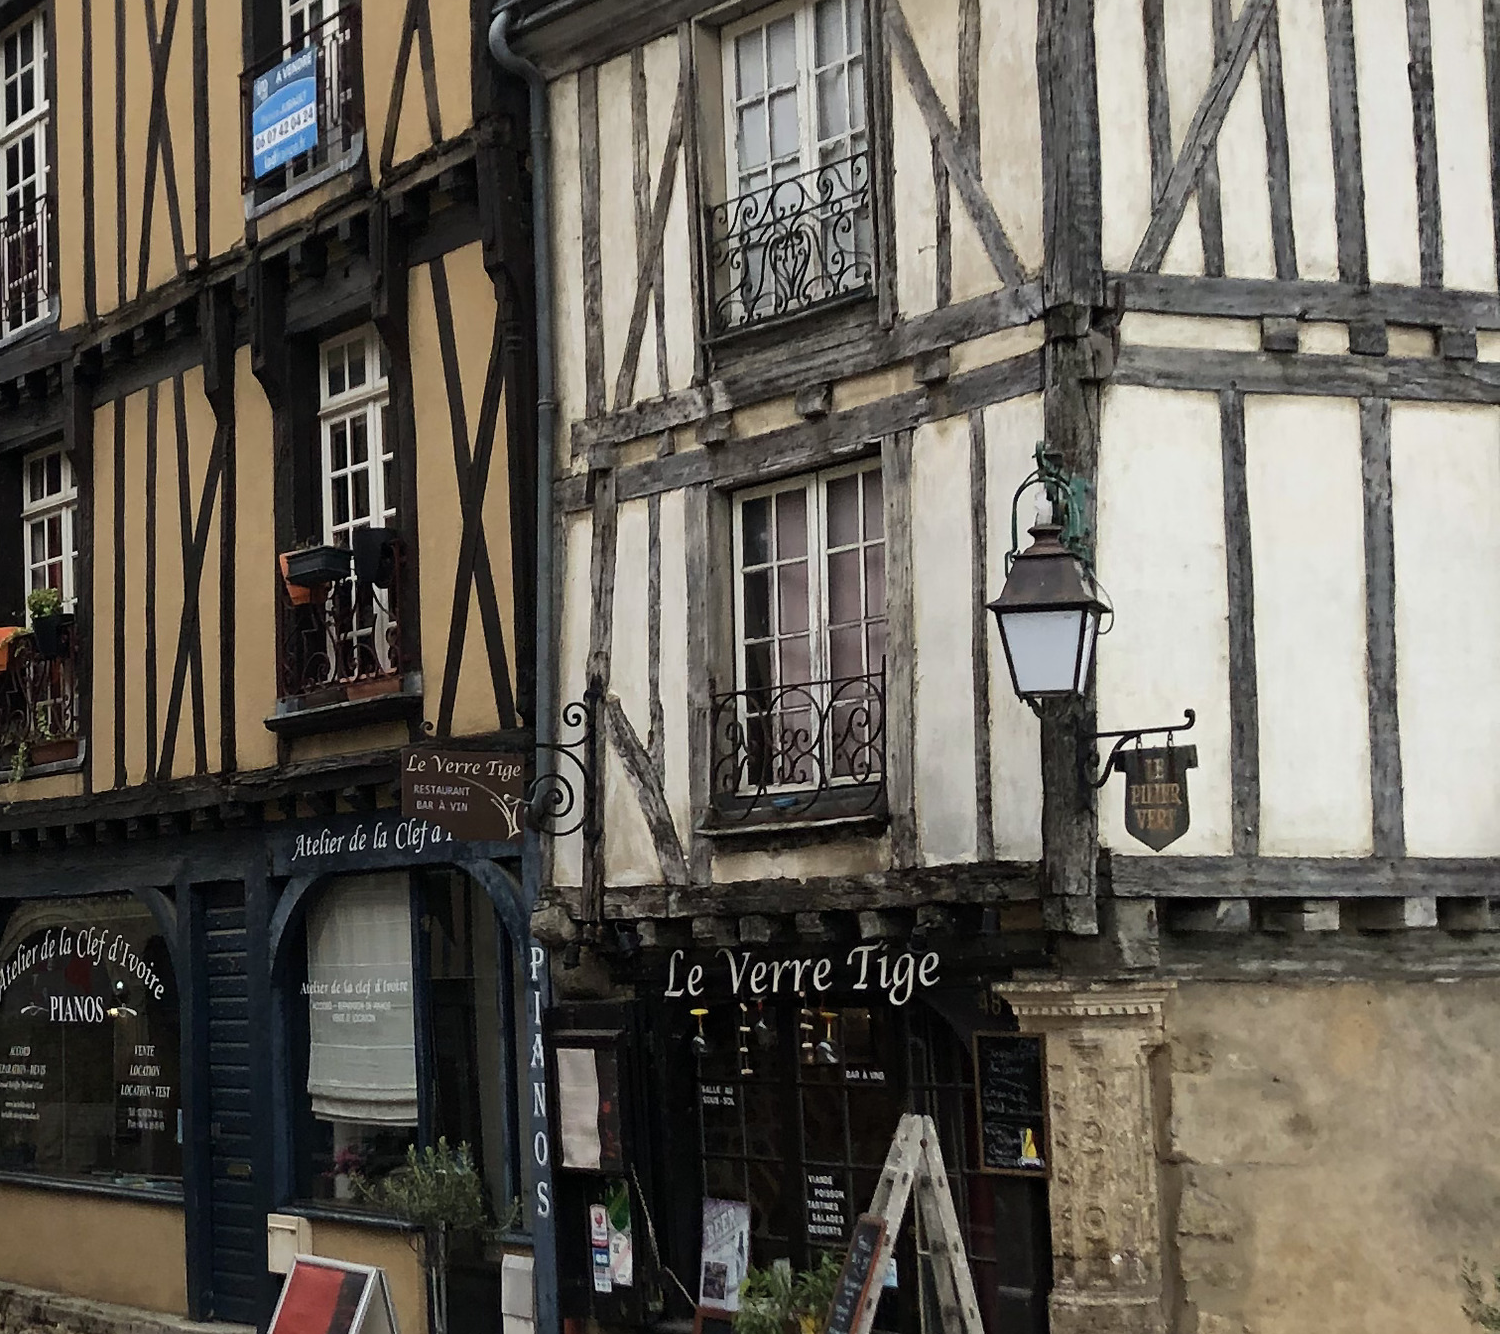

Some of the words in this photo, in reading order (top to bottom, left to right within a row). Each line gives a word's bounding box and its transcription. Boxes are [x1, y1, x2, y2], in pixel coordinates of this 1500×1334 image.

[279, 121, 289, 136] 42
[303, 107, 313, 122] 24
[406, 753, 426, 772] Le
[430, 754, 481, 775] Verre
[485, 759, 521, 782] Tige
[1145, 758, 1165, 779] LE
[413, 784, 471, 796] RESTAURANT
[416, 800, 434, 810] BAR
[438, 799, 446, 811] À
[449, 801, 468, 812] VIN
[291, 828, 345, 861] Atelier
[348, 824, 367, 852] de
[372, 822, 388, 849] la
[395, 817, 429, 854] Clef
[40, 929, 56, 961] de
[59, 926, 72, 956] la
[76, 926, 109, 966] Clef
[107, 935, 165, 1000] d'Ivoire
[663, 949, 704, 997] Le
[715, 947, 832, 995] Verre
[846, 940, 941, 1006] Tige
[300, 979, 329, 995] Atelier
[331, 978, 341, 994] de
[343, 979, 353, 994] la
[50, 995, 104, 1023] PIANOS
[134, 1045, 155, 1057] VENTE
[129, 1064, 161, 1077] LOCATION
[120, 1084, 151, 1097] LOCATION
[155, 1085, 171, 1098] TEST
[529, 946, 550, 1217] PIANOS
[814, 1188, 846, 1199] POISSON
[811, 1213, 845, 1225] SALADES
